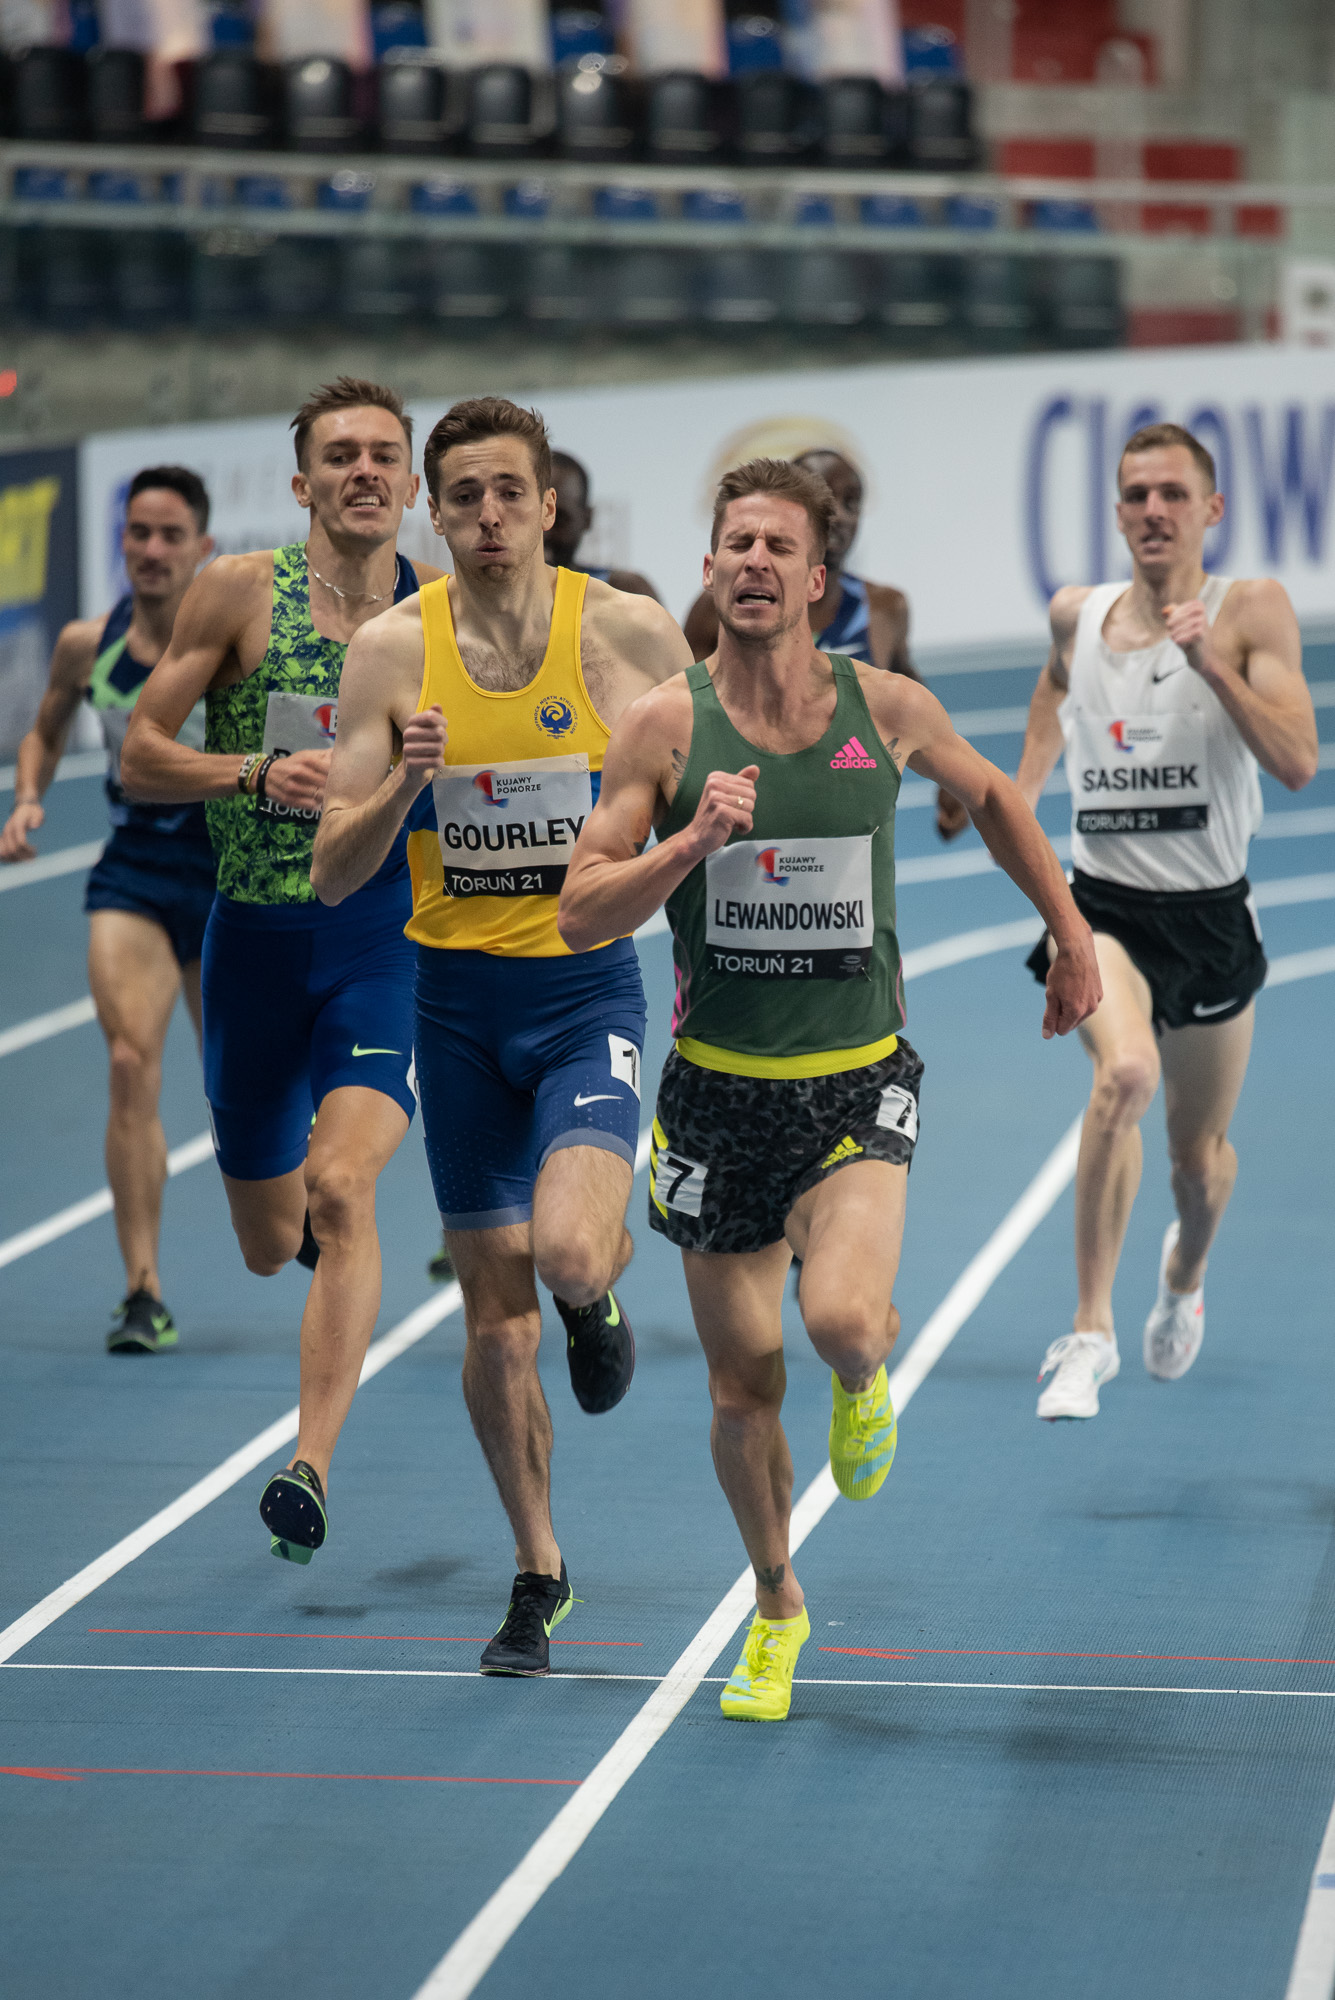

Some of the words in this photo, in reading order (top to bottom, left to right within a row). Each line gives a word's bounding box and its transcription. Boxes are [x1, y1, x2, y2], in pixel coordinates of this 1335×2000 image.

[1022, 394, 1335, 606] CIOW
[540, 696, 557, 705] NORTH
[559, 696, 578, 719] ATHLETICS
[830, 756, 877, 769] adidas
[496, 776, 532, 786] KUJAWY
[497, 783, 542, 794] POMORZE
[1082, 764, 1199, 792] SASINEK
[1137, 812, 1159, 829] 21
[444, 815, 585, 851] GOURLEY
[779, 856, 816, 864] KUJAWY
[779, 864, 824, 873] POMORZE
[451, 872, 515, 893] TORUŃ
[520, 873, 543, 890] 21
[715, 899, 865, 930] LEWANDOWSKI
[714, 953, 784, 974] TORUŃ
[790, 957, 814, 974] 21
[821, 1146, 864, 1169] adidas
[666, 1157, 694, 1204] 7
